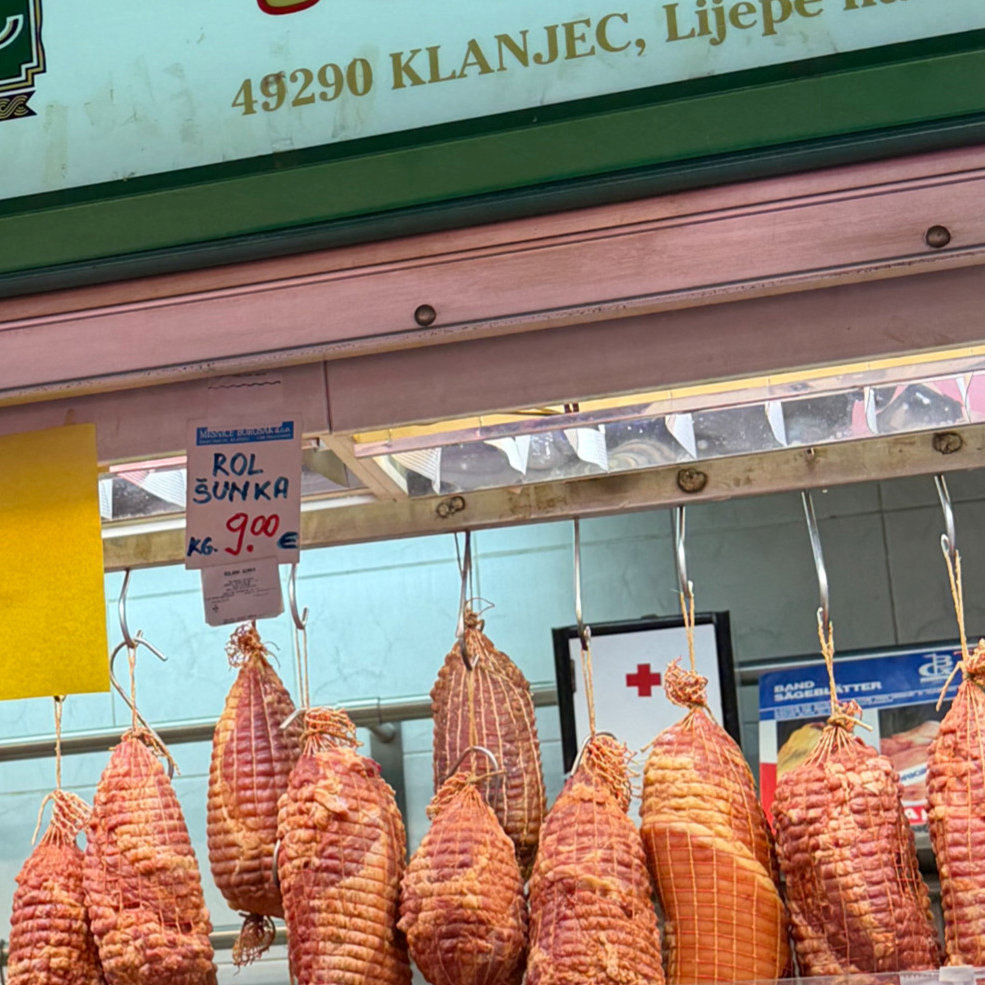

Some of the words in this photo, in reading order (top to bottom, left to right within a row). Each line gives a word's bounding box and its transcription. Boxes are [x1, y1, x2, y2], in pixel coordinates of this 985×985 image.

[232, 58, 373, 117] 49290
[391, 13, 646, 91] KLANJEC,
[212, 452, 263, 477] ROL
[193, 477, 289, 504] ŠUNKA
[774, 680, 815, 694] BAND
